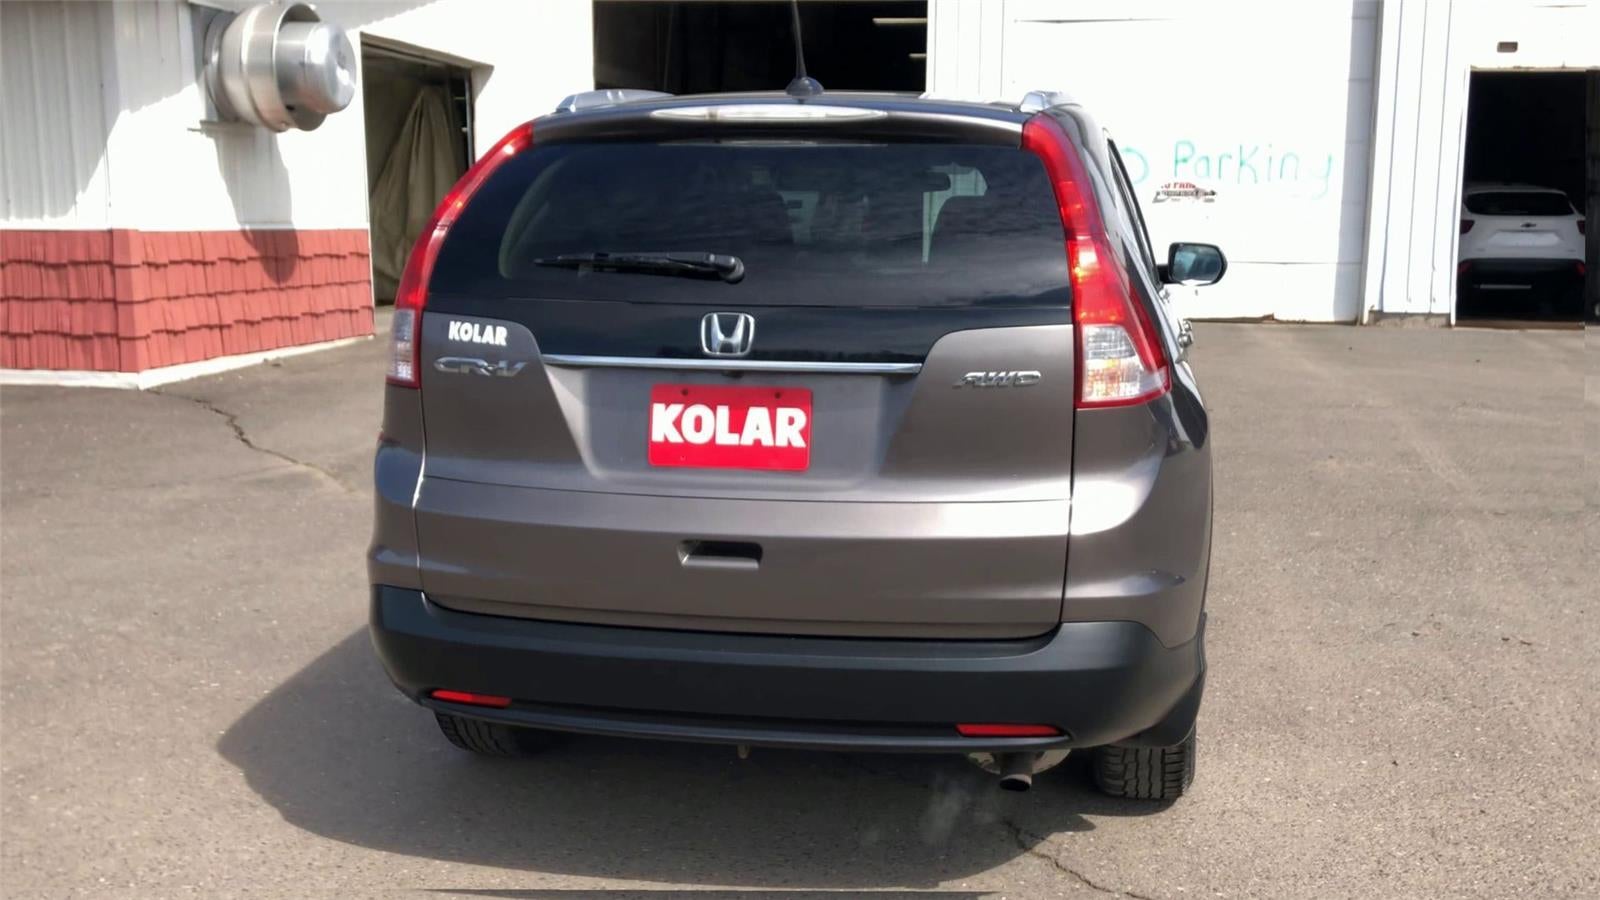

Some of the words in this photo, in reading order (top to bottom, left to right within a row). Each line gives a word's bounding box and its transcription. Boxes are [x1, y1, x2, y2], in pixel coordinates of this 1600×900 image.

[449, 321, 507, 346] KOLAR
[434, 356, 527, 377] CR-V
[954, 371, 1042, 387] AWD
[651, 403, 807, 448] KOLAR
